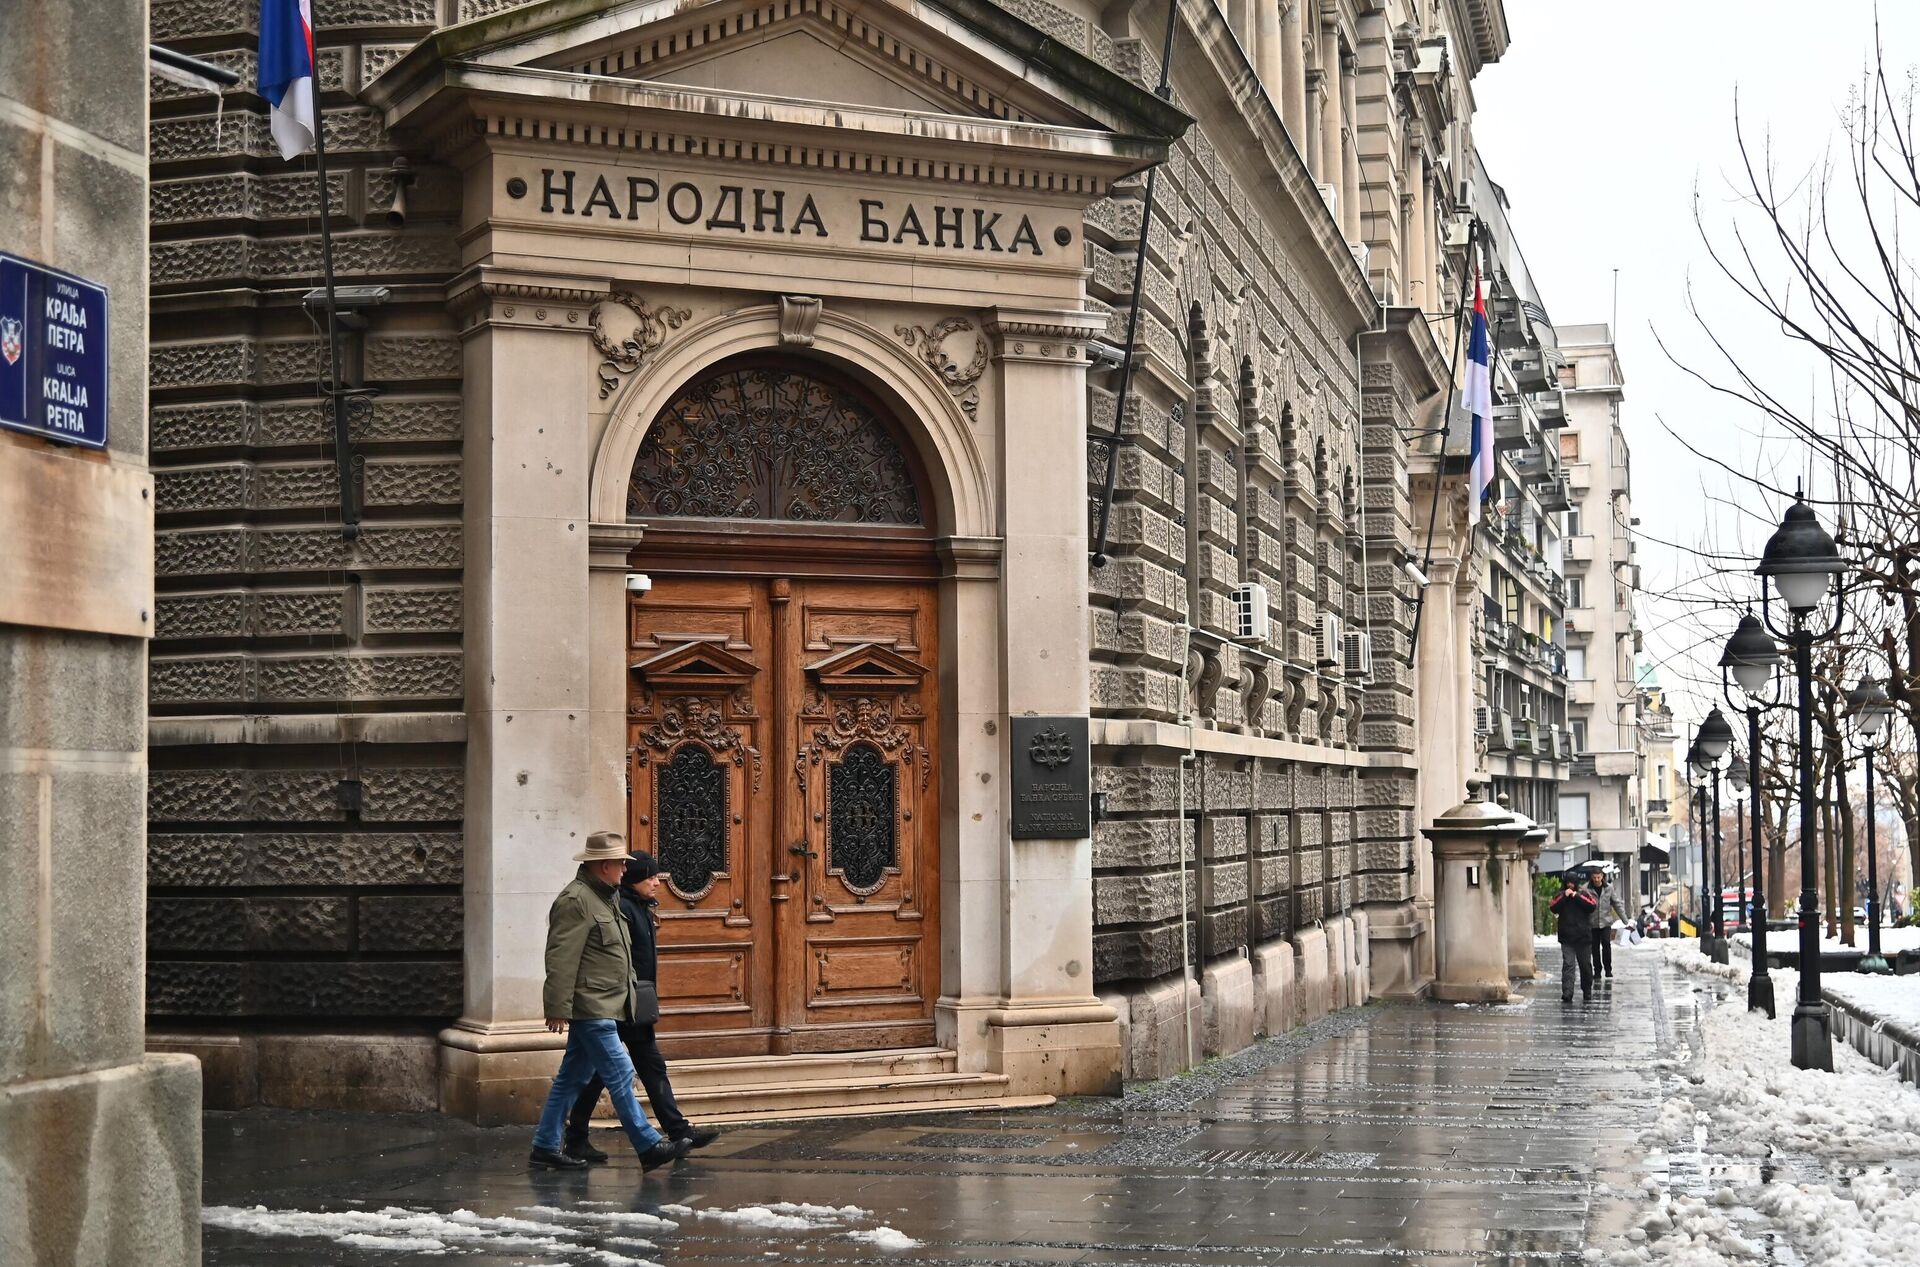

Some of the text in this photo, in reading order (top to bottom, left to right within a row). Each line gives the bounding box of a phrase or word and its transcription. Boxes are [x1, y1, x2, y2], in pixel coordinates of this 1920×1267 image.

[540, 167, 1044, 256] НАРОДНА БАНКА
[57, 282, 80, 299] УЛИЦА
[46, 297, 87, 329] КРАЉА
[48, 324, 85, 354] ПЕТРА
[57, 362, 76, 377] ULICA
[43, 377, 88, 408] KRALJA
[47, 404, 85, 433] PETRA
